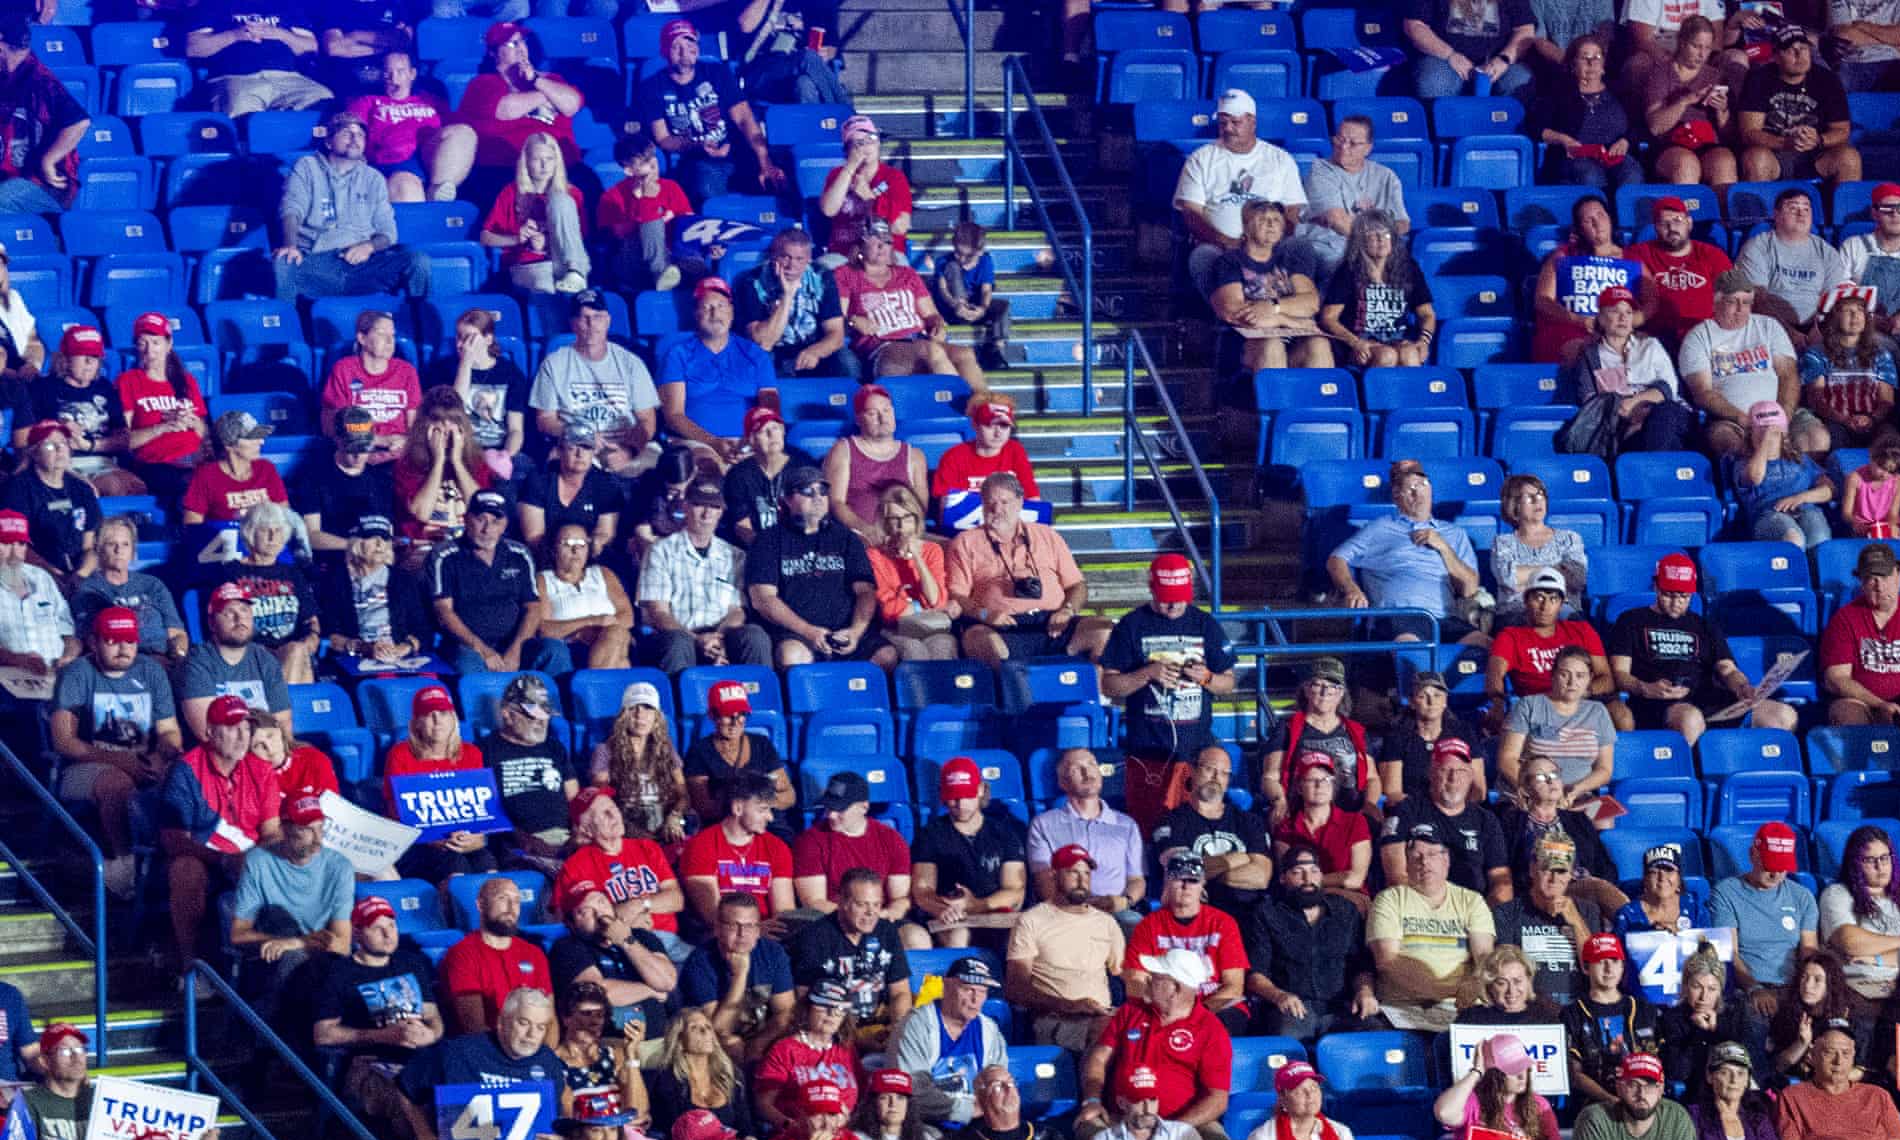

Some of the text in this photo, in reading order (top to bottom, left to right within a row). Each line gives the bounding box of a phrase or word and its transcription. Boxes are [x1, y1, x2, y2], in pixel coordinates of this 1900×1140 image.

[1571, 265, 1627, 284] BRING
[1649, 630, 1694, 644] TRUMP
[1658, 643, 1689, 656] 2024
[400, 786, 492, 811] TRUMP
[415, 806, 489, 824] VANCE
[1459, 1043, 1558, 1062] TMP
[103, 1097, 206, 1133] TRUMP
